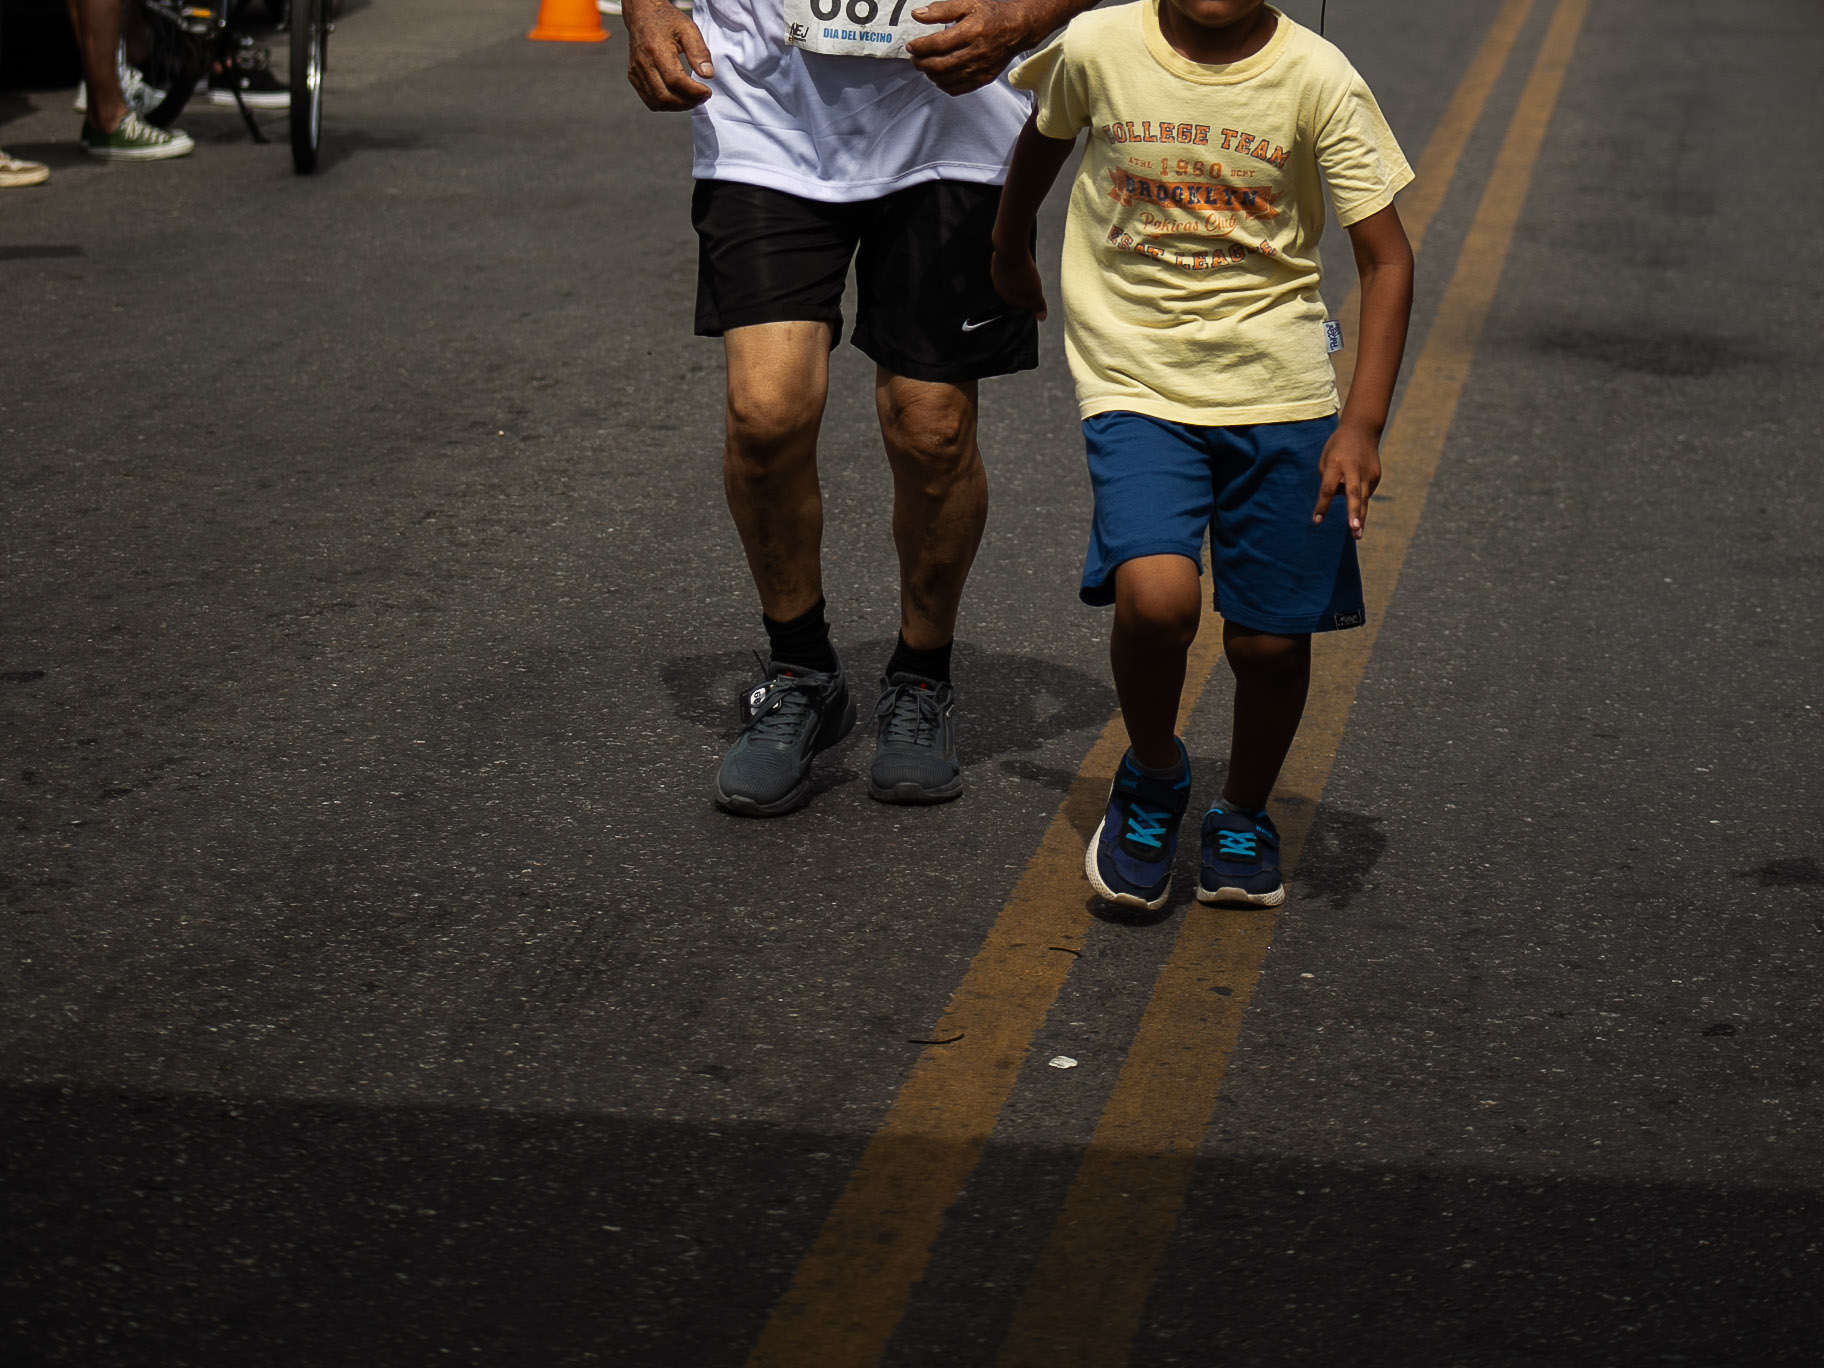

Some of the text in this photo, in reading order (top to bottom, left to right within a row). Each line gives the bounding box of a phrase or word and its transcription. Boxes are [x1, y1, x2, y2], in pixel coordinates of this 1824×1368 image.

[790, 22, 809, 39] NEJ
[823, 27, 893, 44] DIA DEL VECINO
[1102, 121, 1292, 169] COLLEGE TEAM
[1128, 156, 1153, 169] ATHL
[1124, 175, 1259, 207] BROOKLYN
[1204, 211, 1239, 234] Club
[1175, 239, 1278, 271] LEAGE
